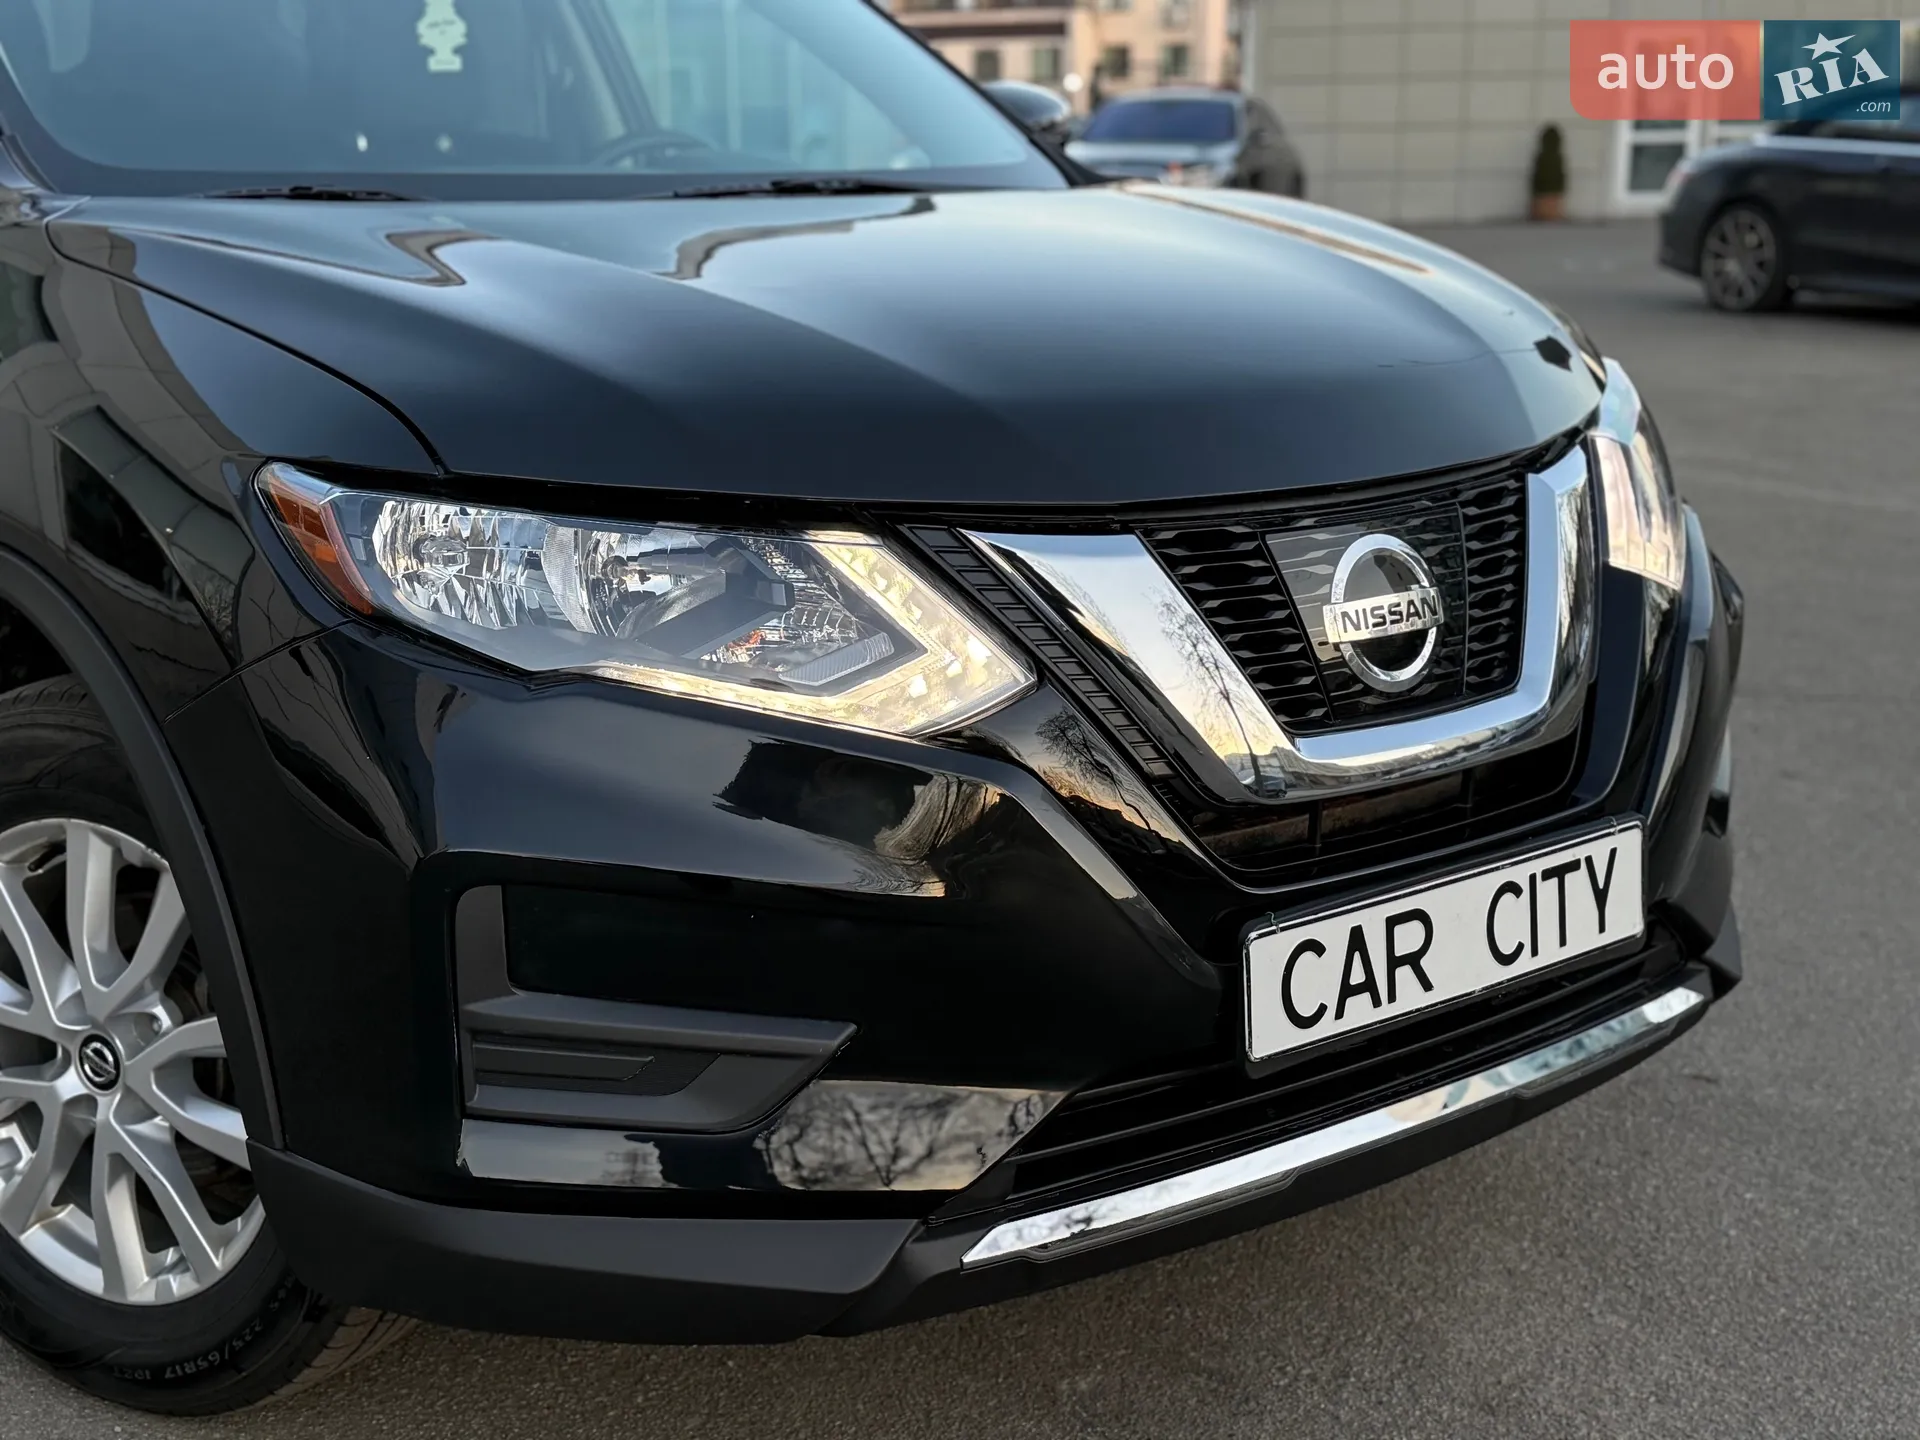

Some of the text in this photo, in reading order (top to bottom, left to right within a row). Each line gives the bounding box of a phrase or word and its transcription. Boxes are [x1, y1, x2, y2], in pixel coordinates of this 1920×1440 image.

[1339, 594, 1438, 634] NISSAN
[1281, 846, 1618, 1030] CAR CITY
[164, 1316, 264, 1380] 225/65R17
